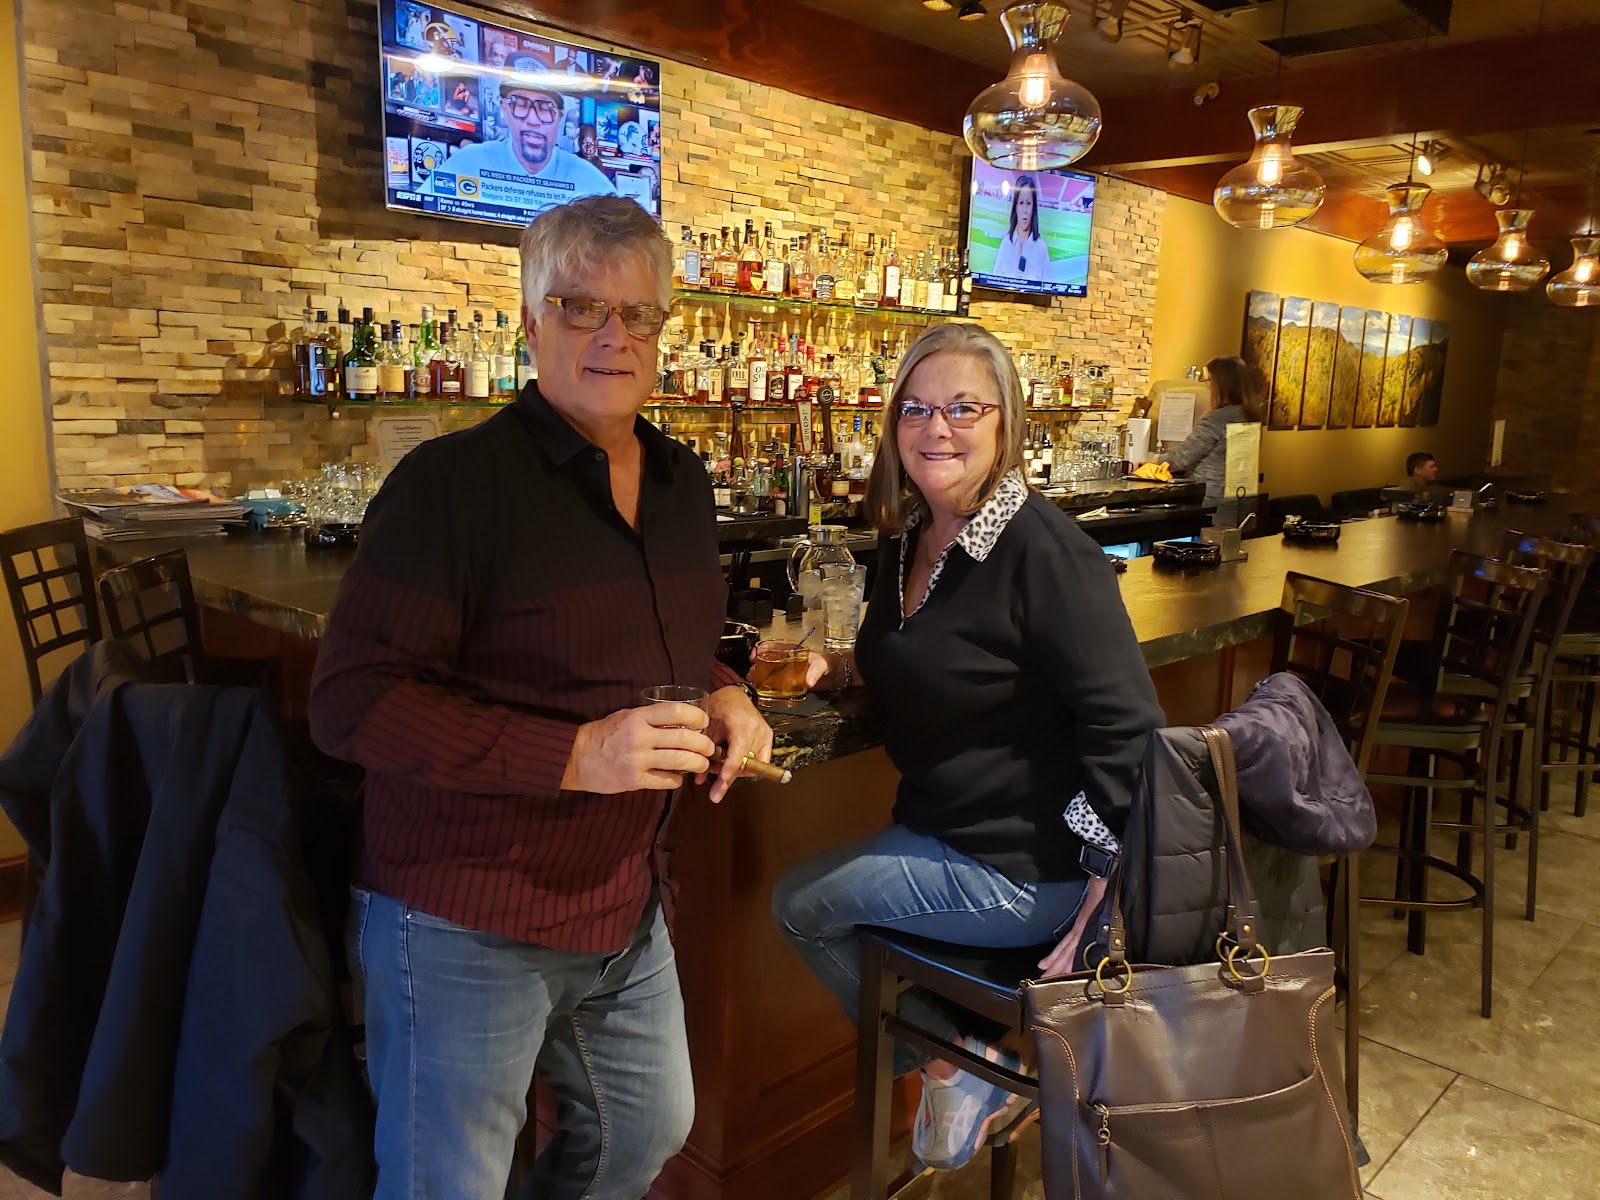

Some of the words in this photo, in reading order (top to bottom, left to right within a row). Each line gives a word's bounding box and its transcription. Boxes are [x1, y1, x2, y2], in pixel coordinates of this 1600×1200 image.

[491, 172, 505, 180] WEEK
[513, 175, 536, 184] PACKERS
[543, 180, 569, 189] SEAHAWKS
[481, 182, 503, 192] Packers
[504, 186, 525, 196] defense
[526, 189, 546, 199] refuses
[440, 197, 454, 205] Rams
[802, 409, 810, 442] LAGER
